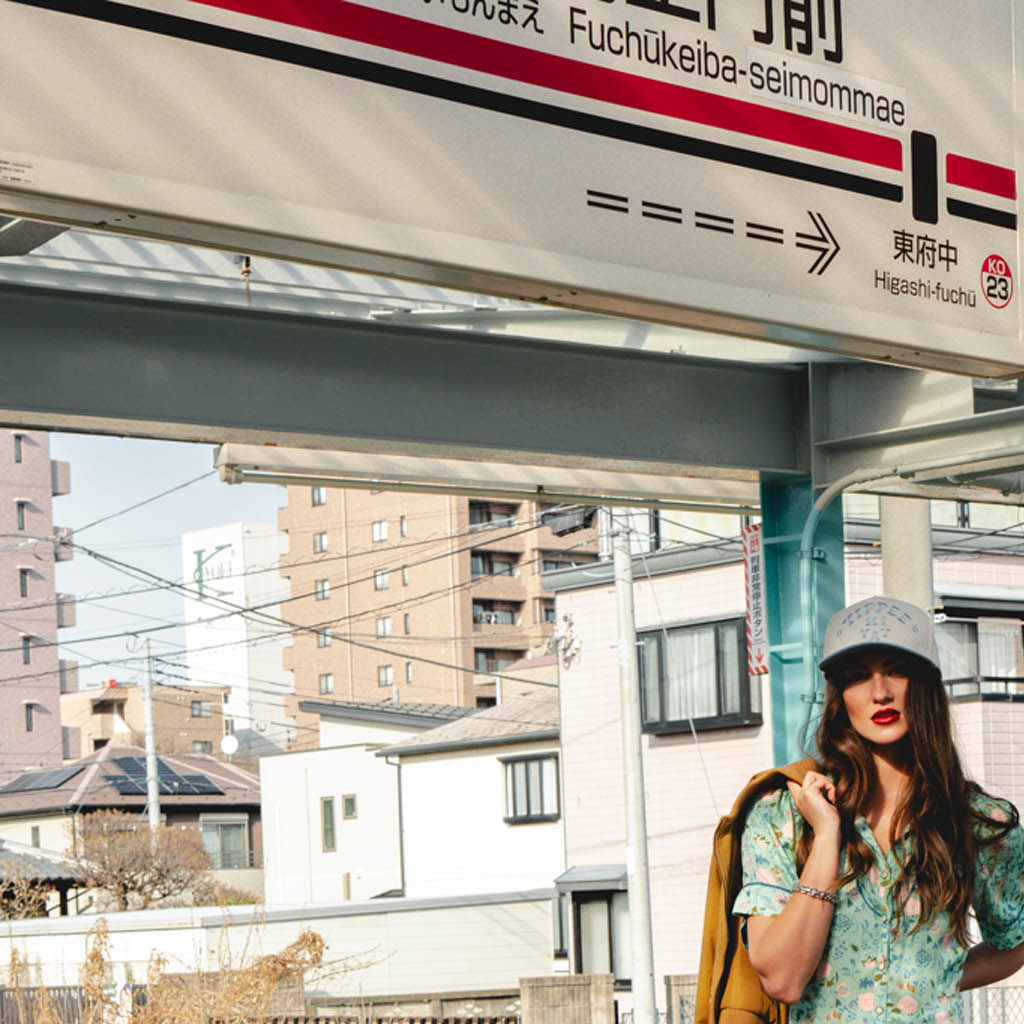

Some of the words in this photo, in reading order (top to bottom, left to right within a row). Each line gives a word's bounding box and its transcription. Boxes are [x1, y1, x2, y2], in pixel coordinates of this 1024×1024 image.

[569, 7, 905, 126] Fuchūkeiba-seimommae
[893, 229, 958, 272] 東府中
[988, 258, 1006, 275] KO
[874, 269, 977, 308] Higashi-fuchū
[986, 275, 1009, 301] 23
